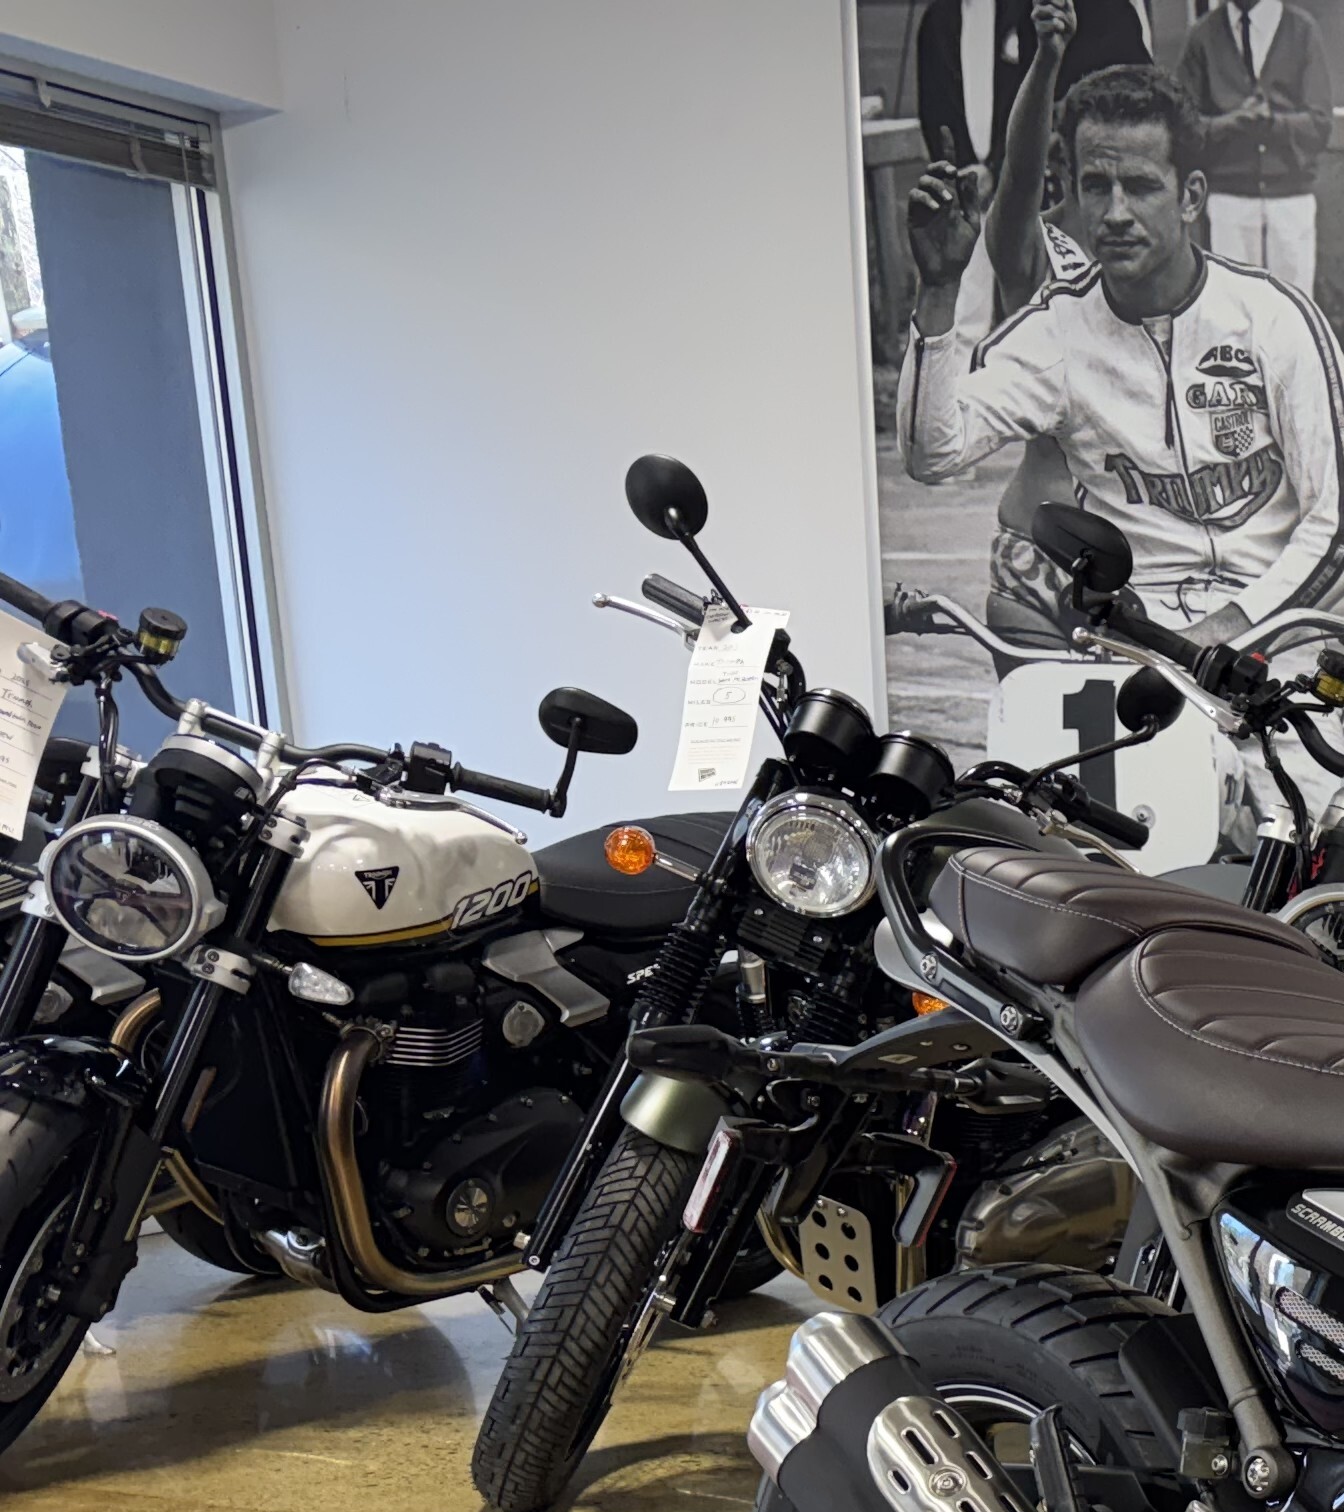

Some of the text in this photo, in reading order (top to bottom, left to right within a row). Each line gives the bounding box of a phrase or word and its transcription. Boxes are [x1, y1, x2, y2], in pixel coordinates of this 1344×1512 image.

[1198, 345, 1256, 368] ABC
[1214, 411, 1250, 432] CASTROL
[1104, 447, 1283, 527] TRIUMPH
[450, 871, 532, 930] 1200
